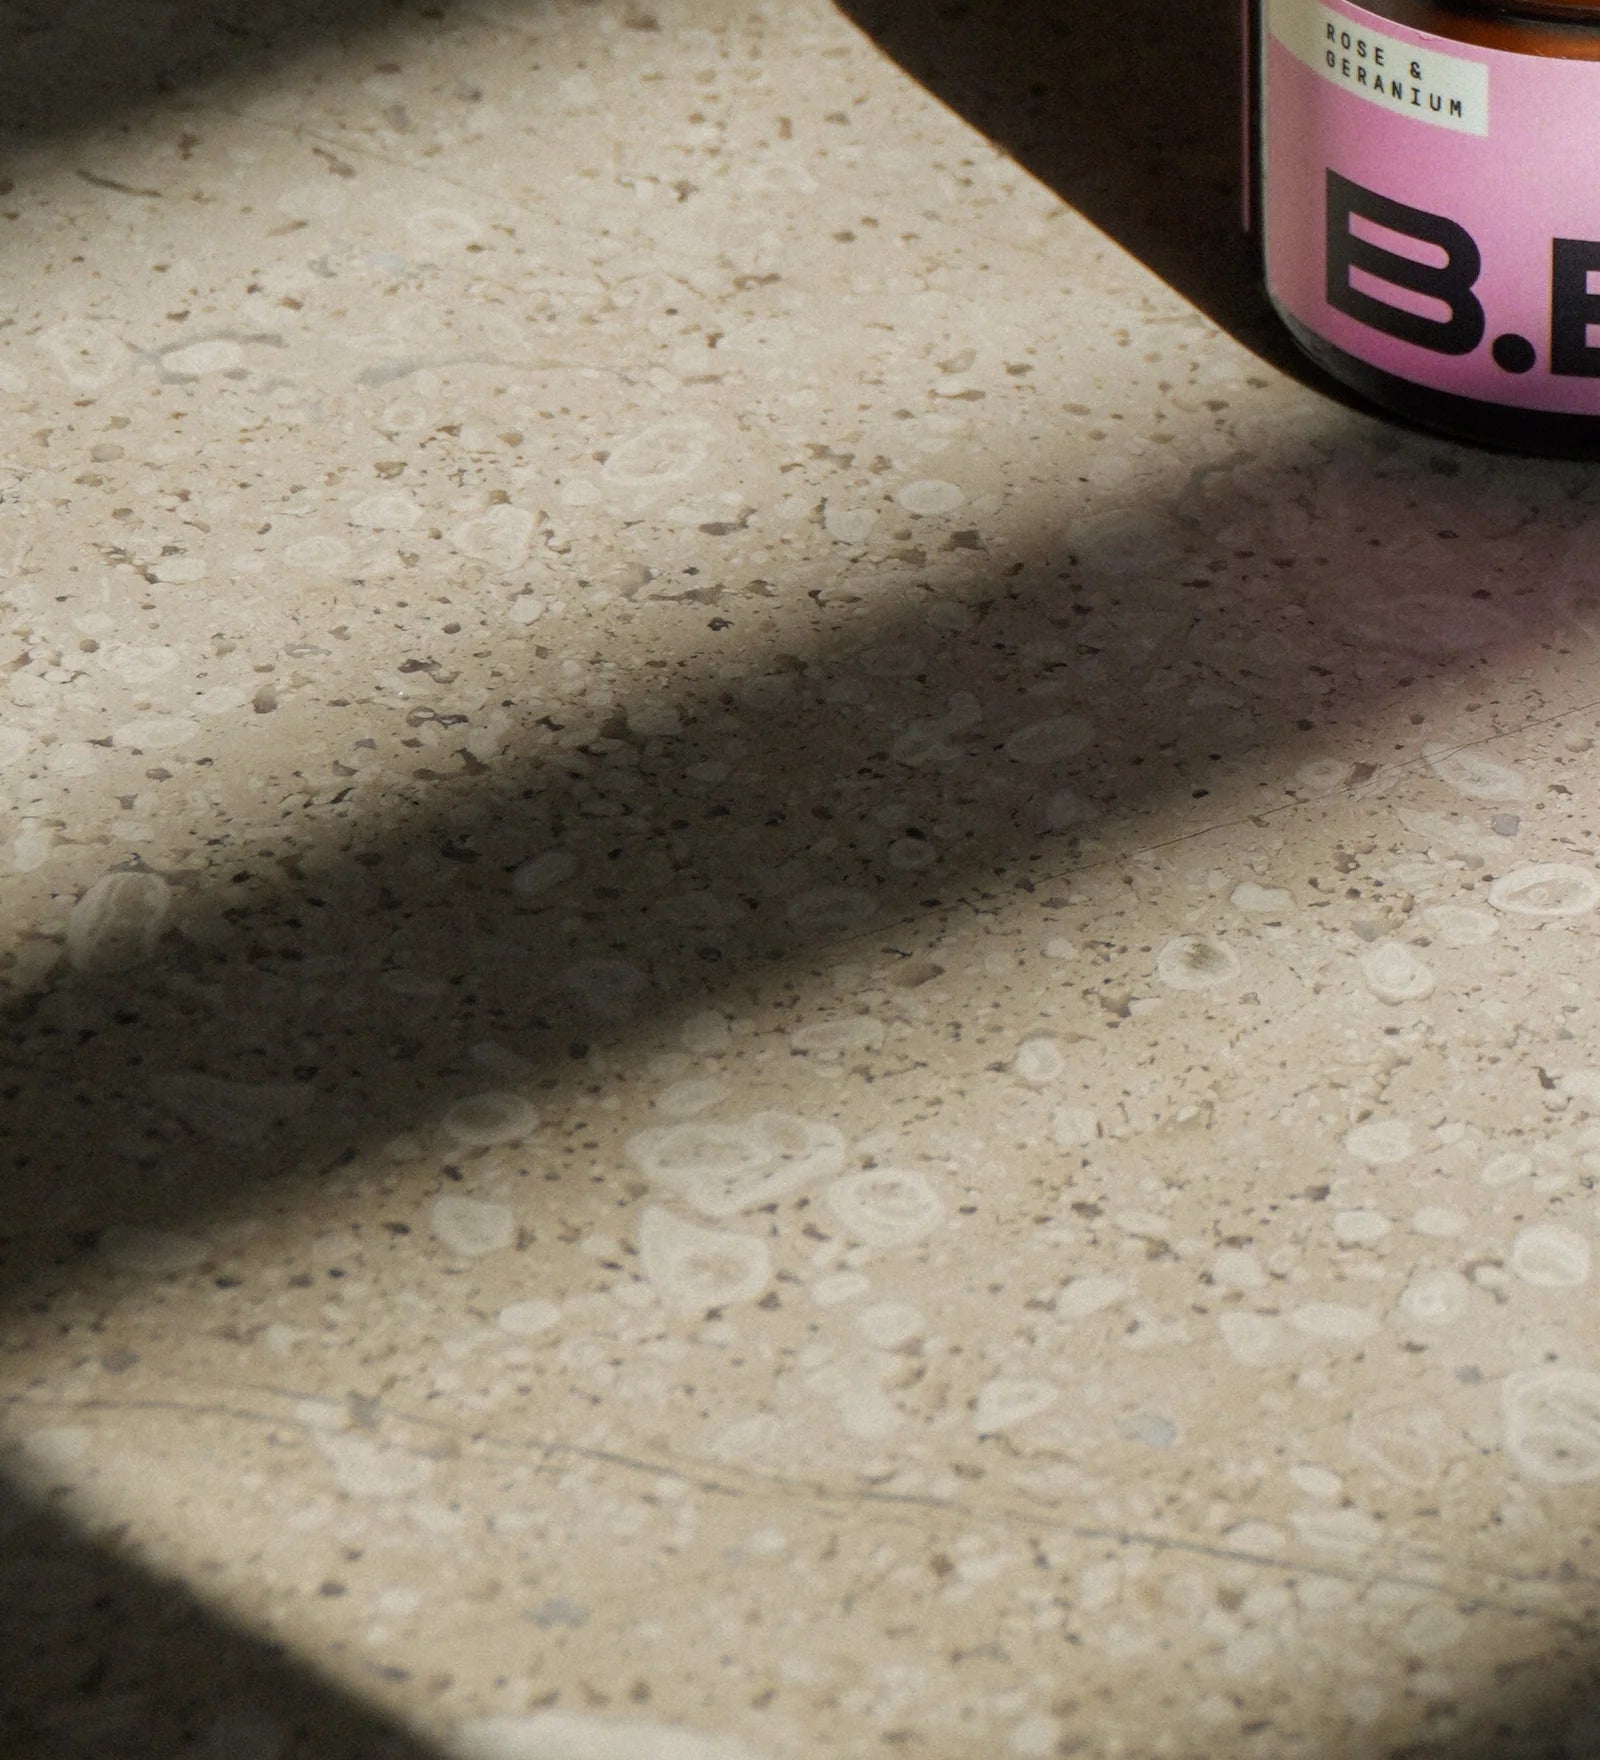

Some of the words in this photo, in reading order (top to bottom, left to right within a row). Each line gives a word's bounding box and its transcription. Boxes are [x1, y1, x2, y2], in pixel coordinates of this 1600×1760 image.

[1326, 22, 1386, 67] ROSE
[1410, 60, 1422, 81] &
[1326, 49, 1463, 118] GERANIUM
